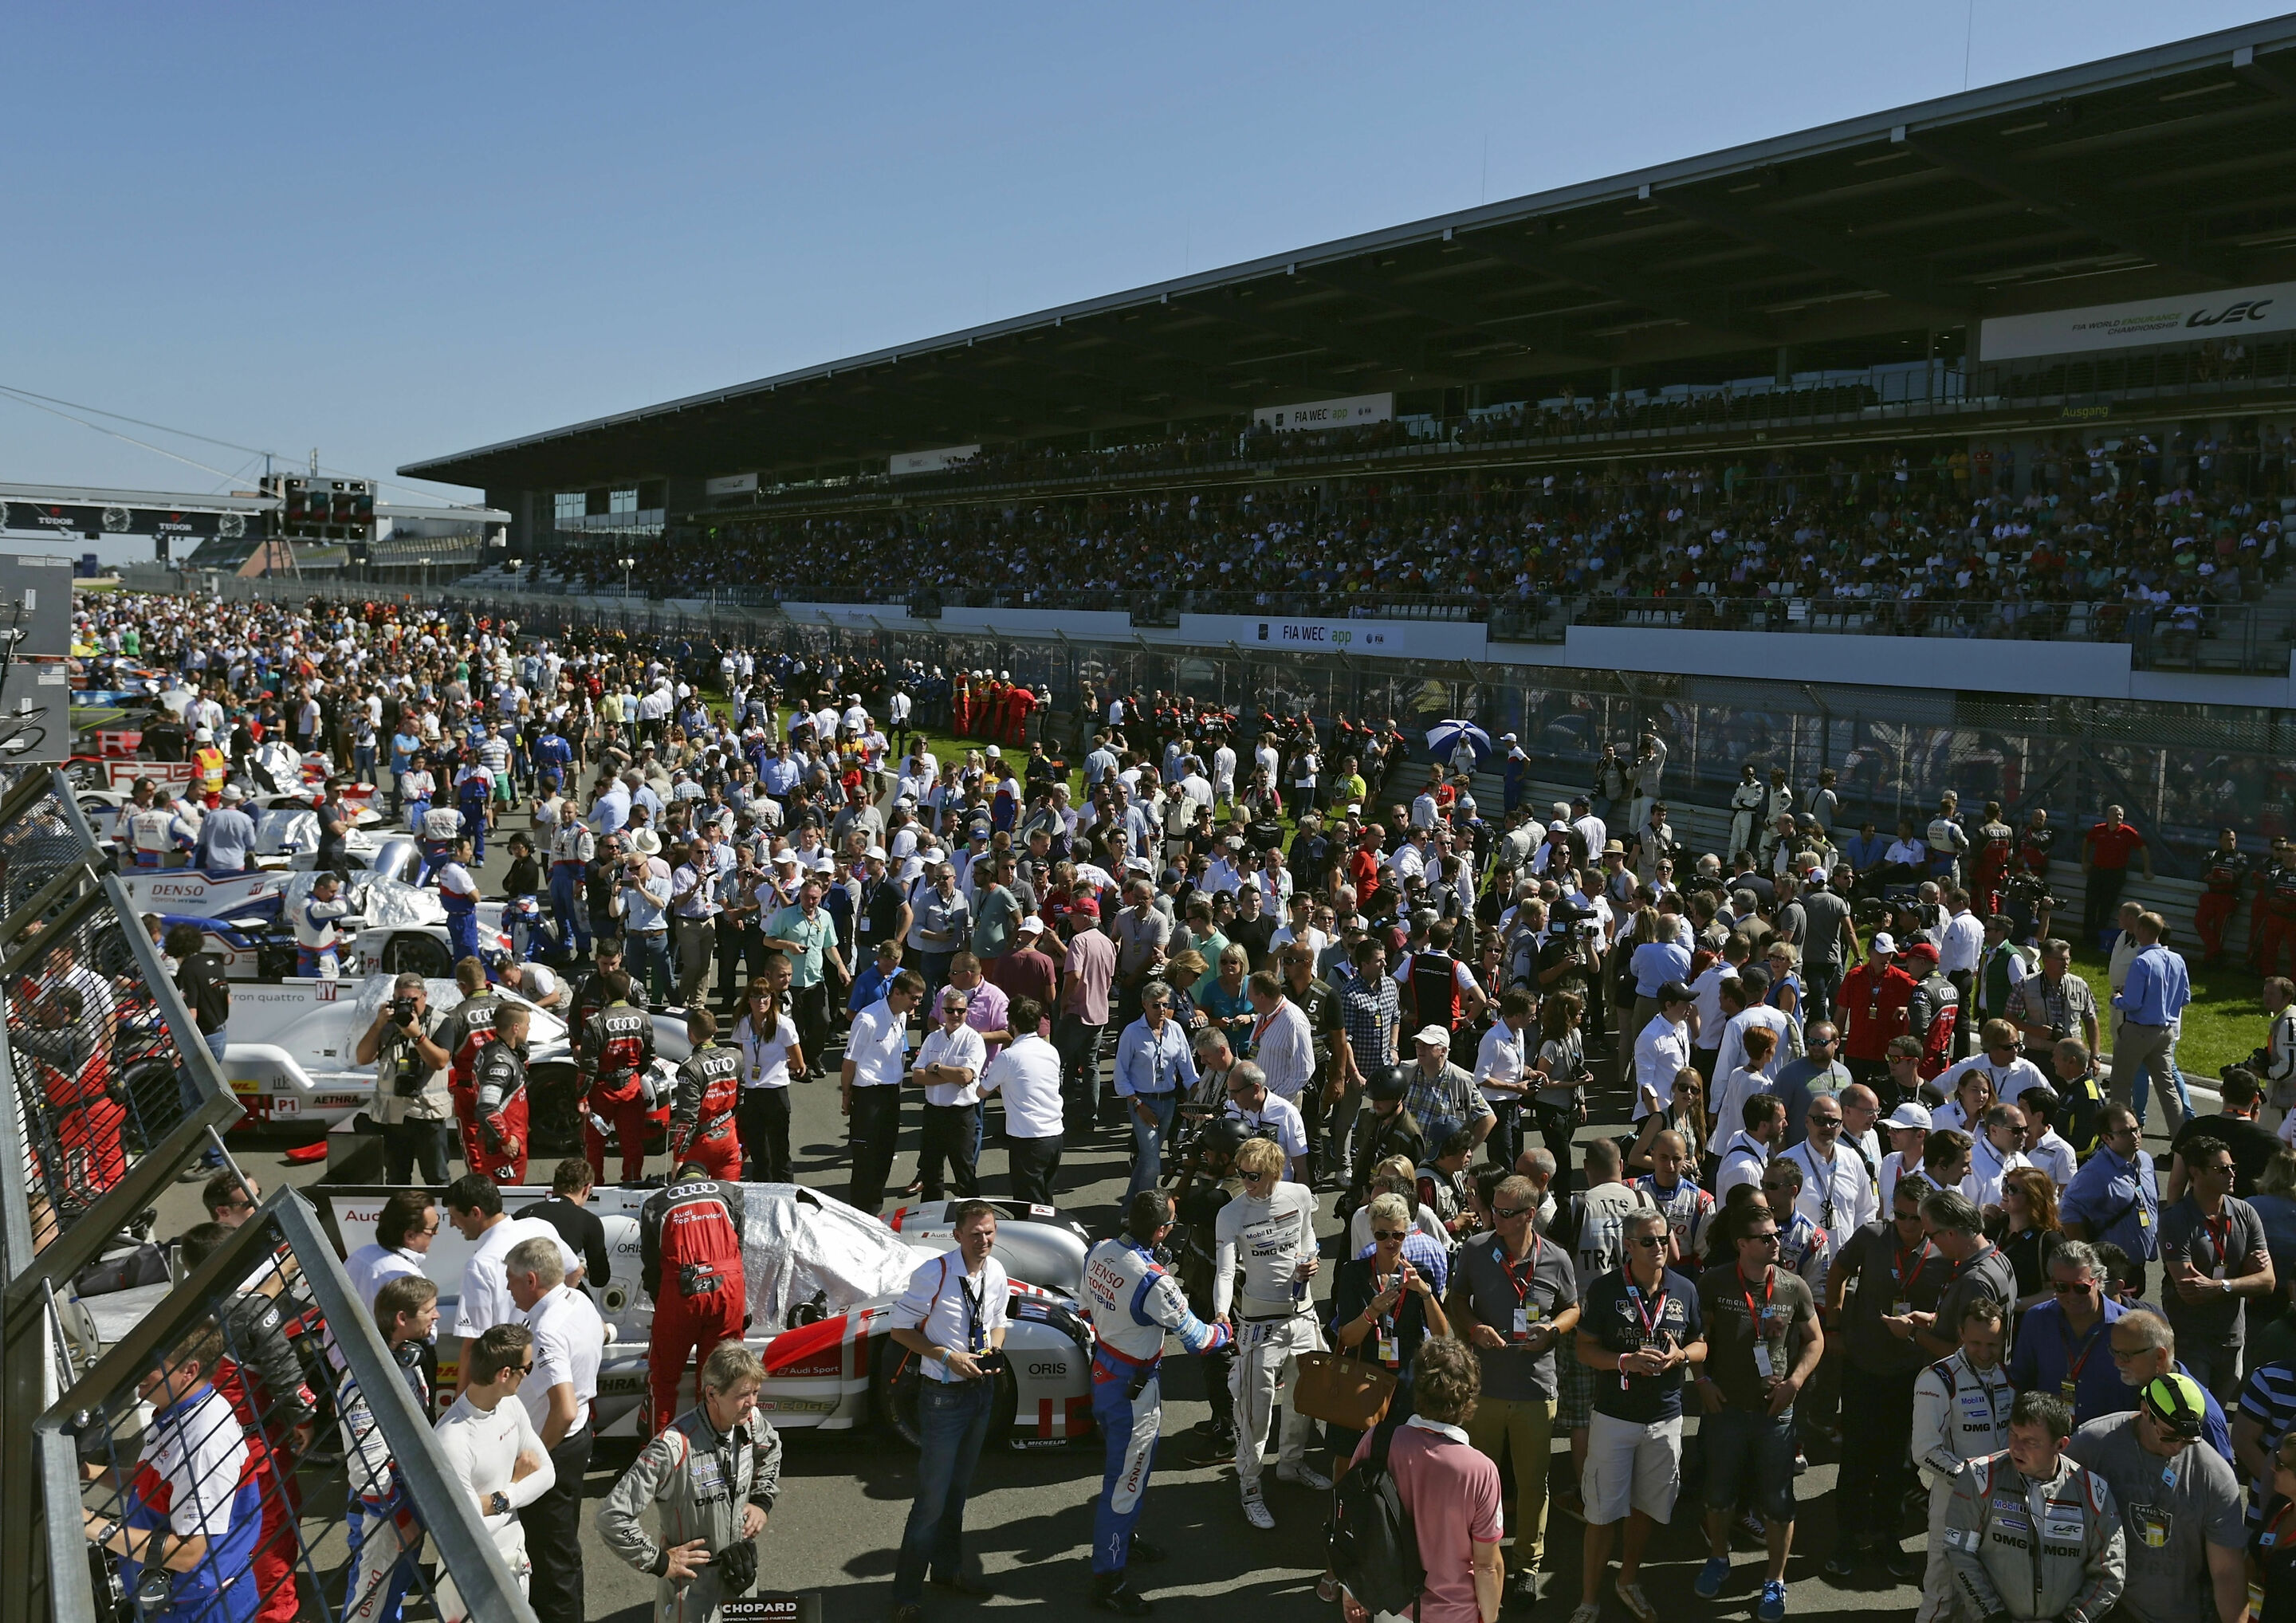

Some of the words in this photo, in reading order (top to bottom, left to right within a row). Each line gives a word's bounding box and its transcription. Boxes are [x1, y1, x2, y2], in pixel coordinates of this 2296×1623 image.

[2185, 299, 2274, 328] WEC
[2072, 322, 2087, 332] FIA
[2089, 320, 2121, 330] WORLD
[2121, 312, 2182, 325] ENDURANCE
[2107, 321, 2179, 336] CHAMPIONSHIP
[1295, 411, 1307, 422] FIA
[1310, 408, 1327, 421] WEC
[1332, 407, 1348, 421] app
[2062, 405, 2109, 420] Ausgang
[1283, 625, 1299, 640] FIA
[1301, 626, 1326, 642] WEC
[1331, 629, 1352, 646] app
[151, 884, 205, 896] DENSO
[1415, 968, 1450, 977] PORSCHE
[316, 982, 336, 1000] HY
[258, 993, 305, 1004] quattro
[1307, 1000, 1319, 1013] 5
[273, 1075, 291, 1090] itk
[278, 1101, 296, 1111] P1
[314, 1095, 359, 1104] AETHRA
[673, 1209, 693, 1219] Audi
[674, 1216, 690, 1224] Top
[691, 1212, 722, 1221] Service
[1247, 1231, 1266, 1240] Mobil
[1279, 1240, 1299, 1252] MOR
[1090, 1260, 1125, 1289] DENSO
[1088, 1275, 1116, 1303] TOYOTA
[813, 1366, 840, 1375] Sport
[1028, 1363, 1067, 1374] ORIS
[779, 1401, 835, 1412] EDGE
[1963, 1424, 1991, 1432] DMG
[693, 1463, 716, 1476] Mobil
[1924, 1456, 1946, 1474] DMG
[1127, 1452, 1145, 1493] DENSO
[694, 1492, 726, 1507] DMG
[1993, 1499, 2019, 1511] Mobil
[2053, 1524, 2082, 1534] WEC
[1992, 1532, 2029, 1550] DMG
[2044, 1545, 2081, 1558] MORI
[1958, 1571, 1976, 1598] DMG
[722, 1602, 797, 1613] CHOPARD
